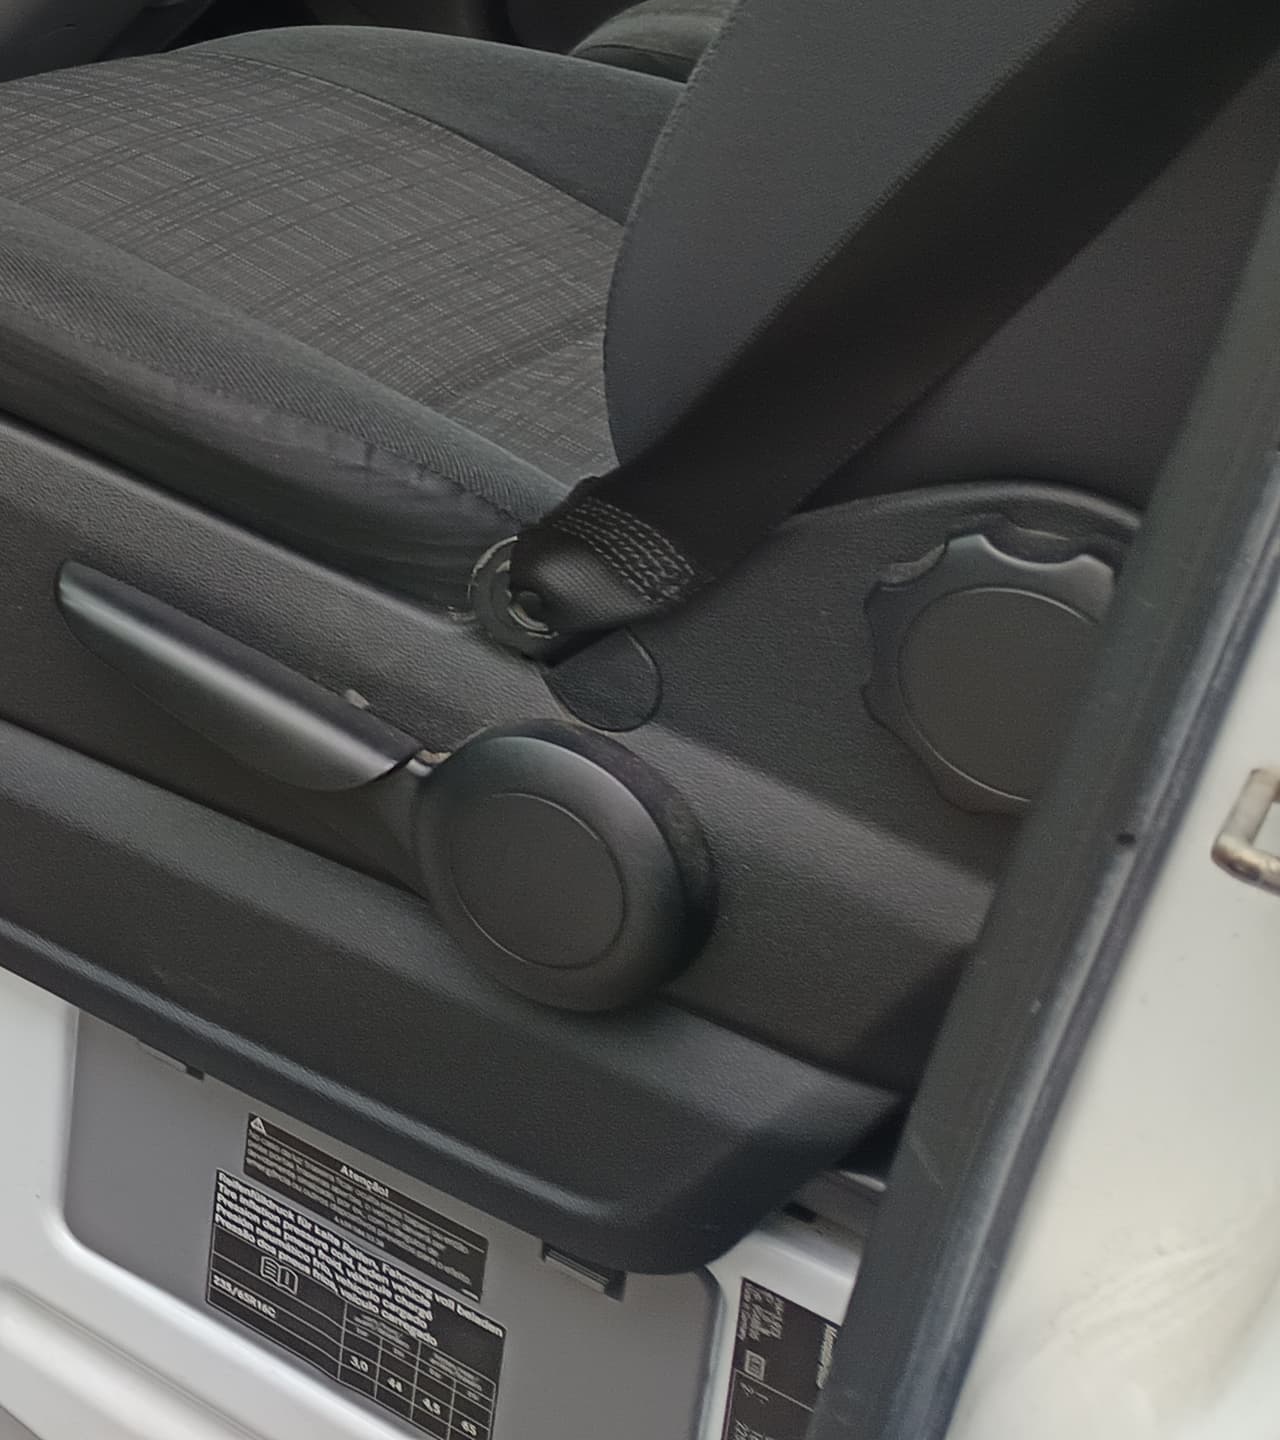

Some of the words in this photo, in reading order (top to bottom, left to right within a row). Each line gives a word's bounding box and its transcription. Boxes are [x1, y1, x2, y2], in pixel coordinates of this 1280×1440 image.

[217, 1193, 260, 1224] Pression
[262, 1220, 281, 1236] des
[284, 1232, 315, 1255] pneus
[395, 1294, 432, 1321] chargé
[218, 1182, 237, 1200] Tire
[240, 1195, 280, 1224] inflation
[283, 1220, 328, 1251] pressure
[331, 1248, 355, 1269] cold,
[358, 1263, 389, 1285] laden
[392, 1281, 430, 1308] vehicle
[343, 1242, 378, 1270] Reifen,
[383, 1263, 432, 1300] Fahrzeug
[435, 1293, 454, 1311] voll
[457, 1304, 502, 1337] beladen
[213, 1274, 277, 1318] 235/65R16C
[278, 1251, 310, 1274] pneus
[381, 1310, 437, 1347] carregado
[382, 1299, 427, 1328] cargado
